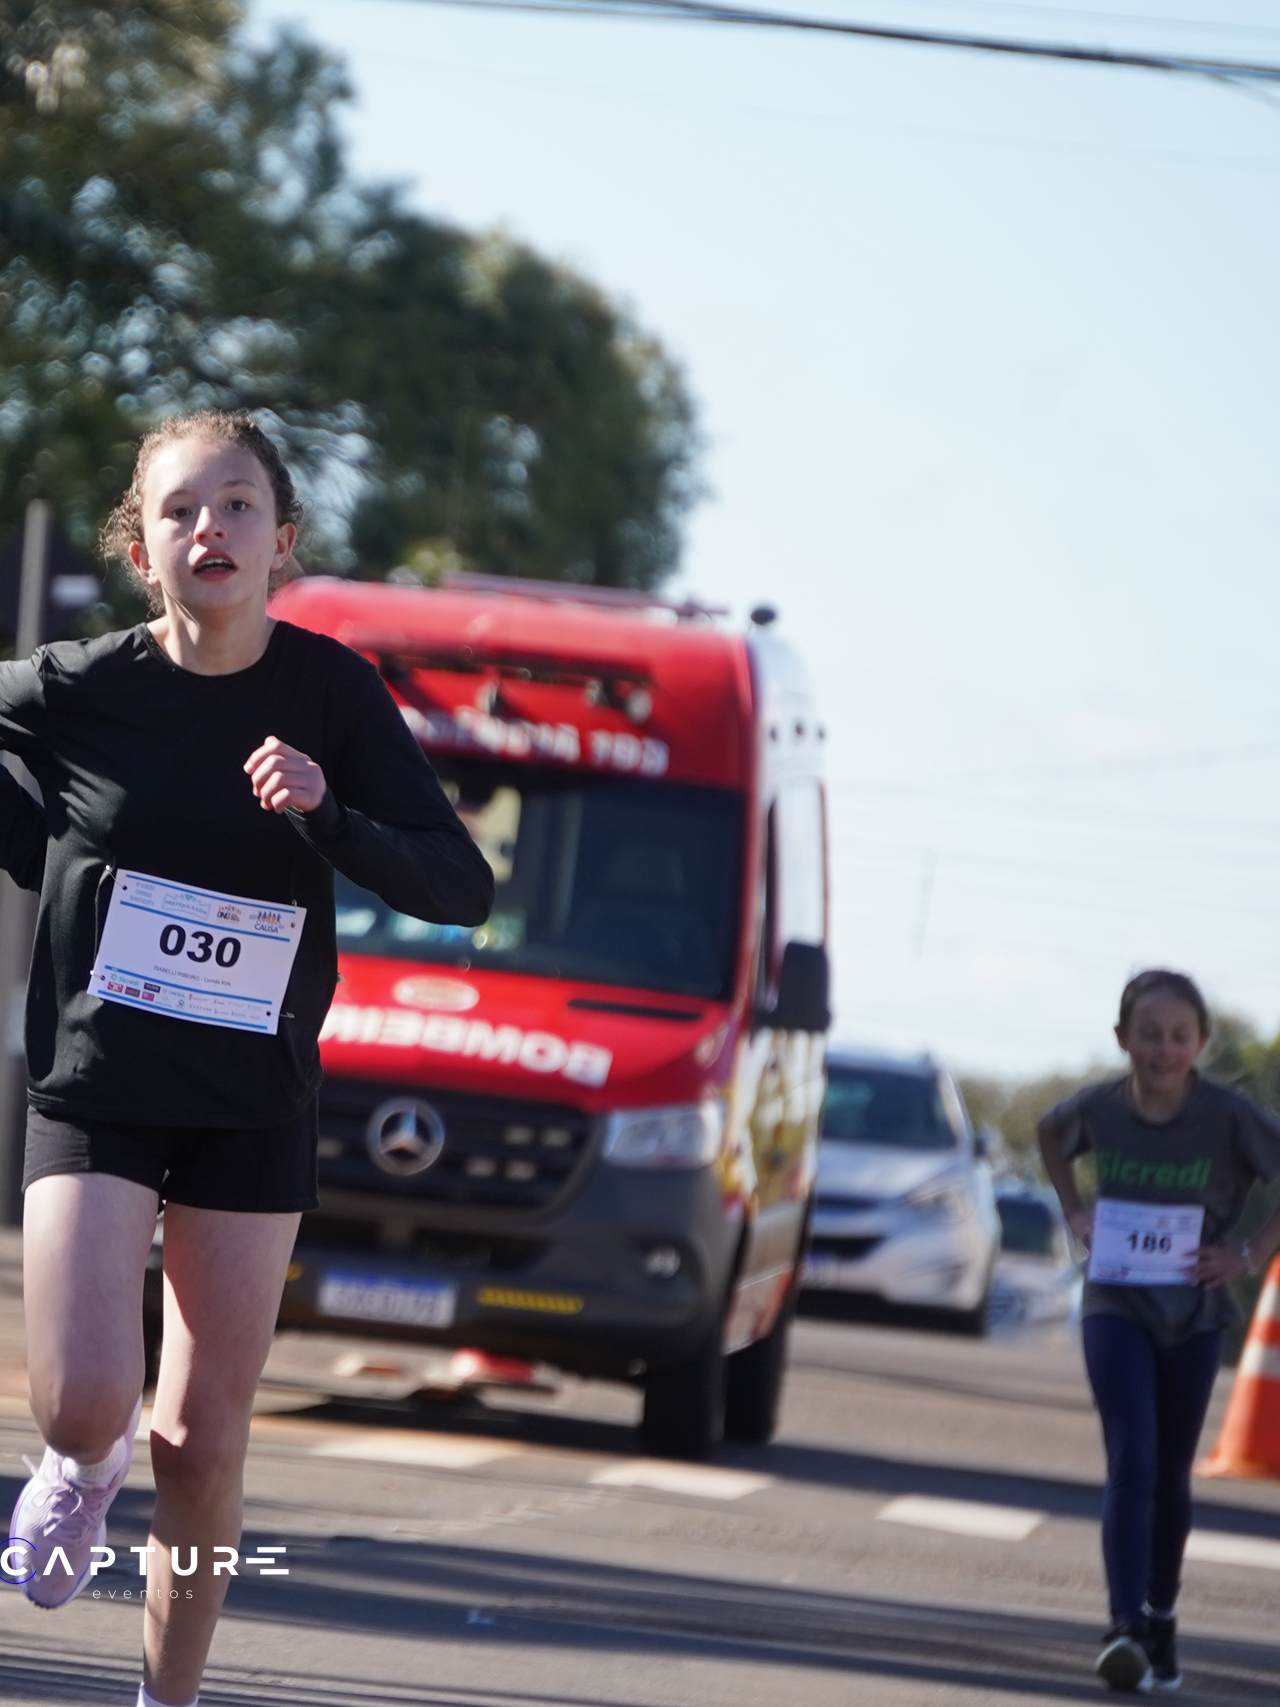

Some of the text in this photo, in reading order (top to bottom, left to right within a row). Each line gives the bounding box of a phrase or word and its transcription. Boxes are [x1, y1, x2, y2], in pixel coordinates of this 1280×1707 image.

[254, 923, 278, 933] CAUSA
[159, 924, 242, 968] 030
[153, 965, 177, 976] ISABELLI
